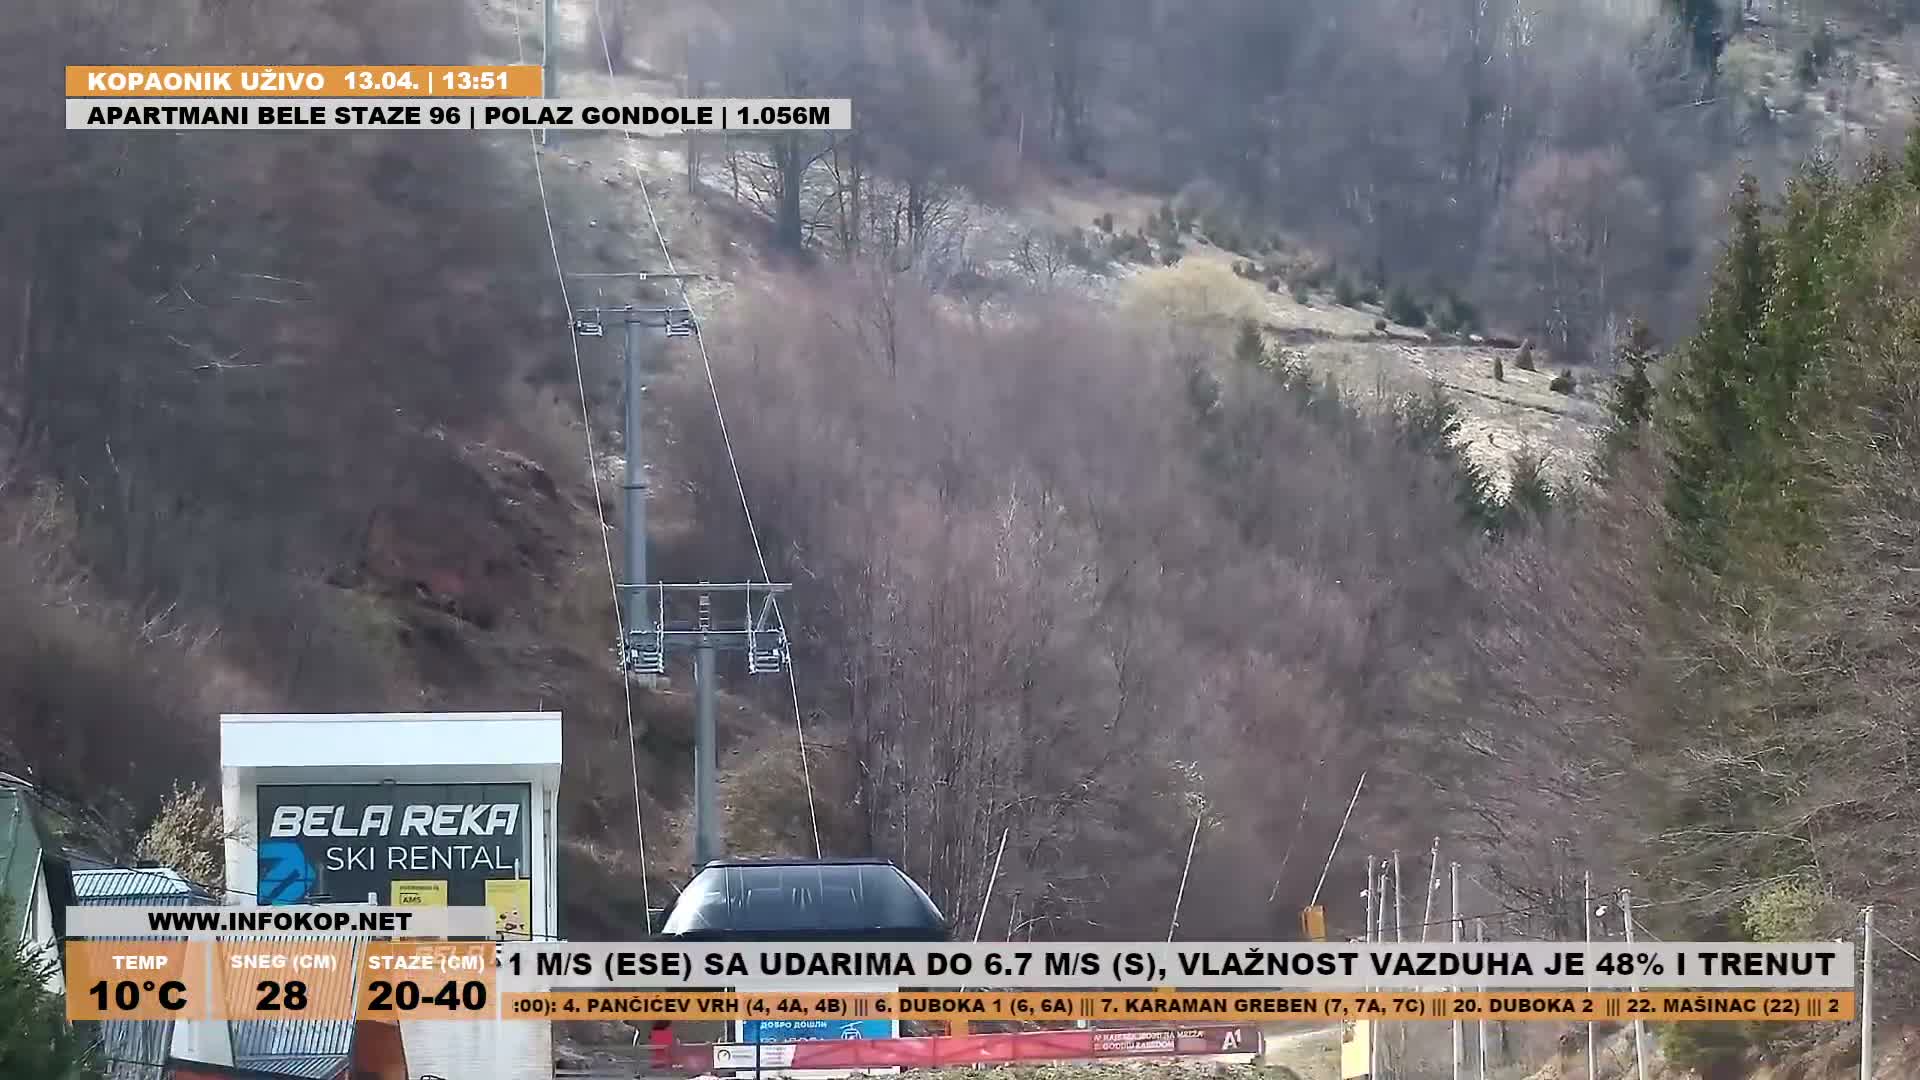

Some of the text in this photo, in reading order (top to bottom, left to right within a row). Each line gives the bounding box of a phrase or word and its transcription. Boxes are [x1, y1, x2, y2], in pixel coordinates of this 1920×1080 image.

[270, 803, 520, 838] BELA REKA
[326, 845, 513, 871] SKI RENTAL
[760, 1020, 828, 1029] ДОБРО ДОШЛИ
[1221, 1028, 1242, 1050] A1
